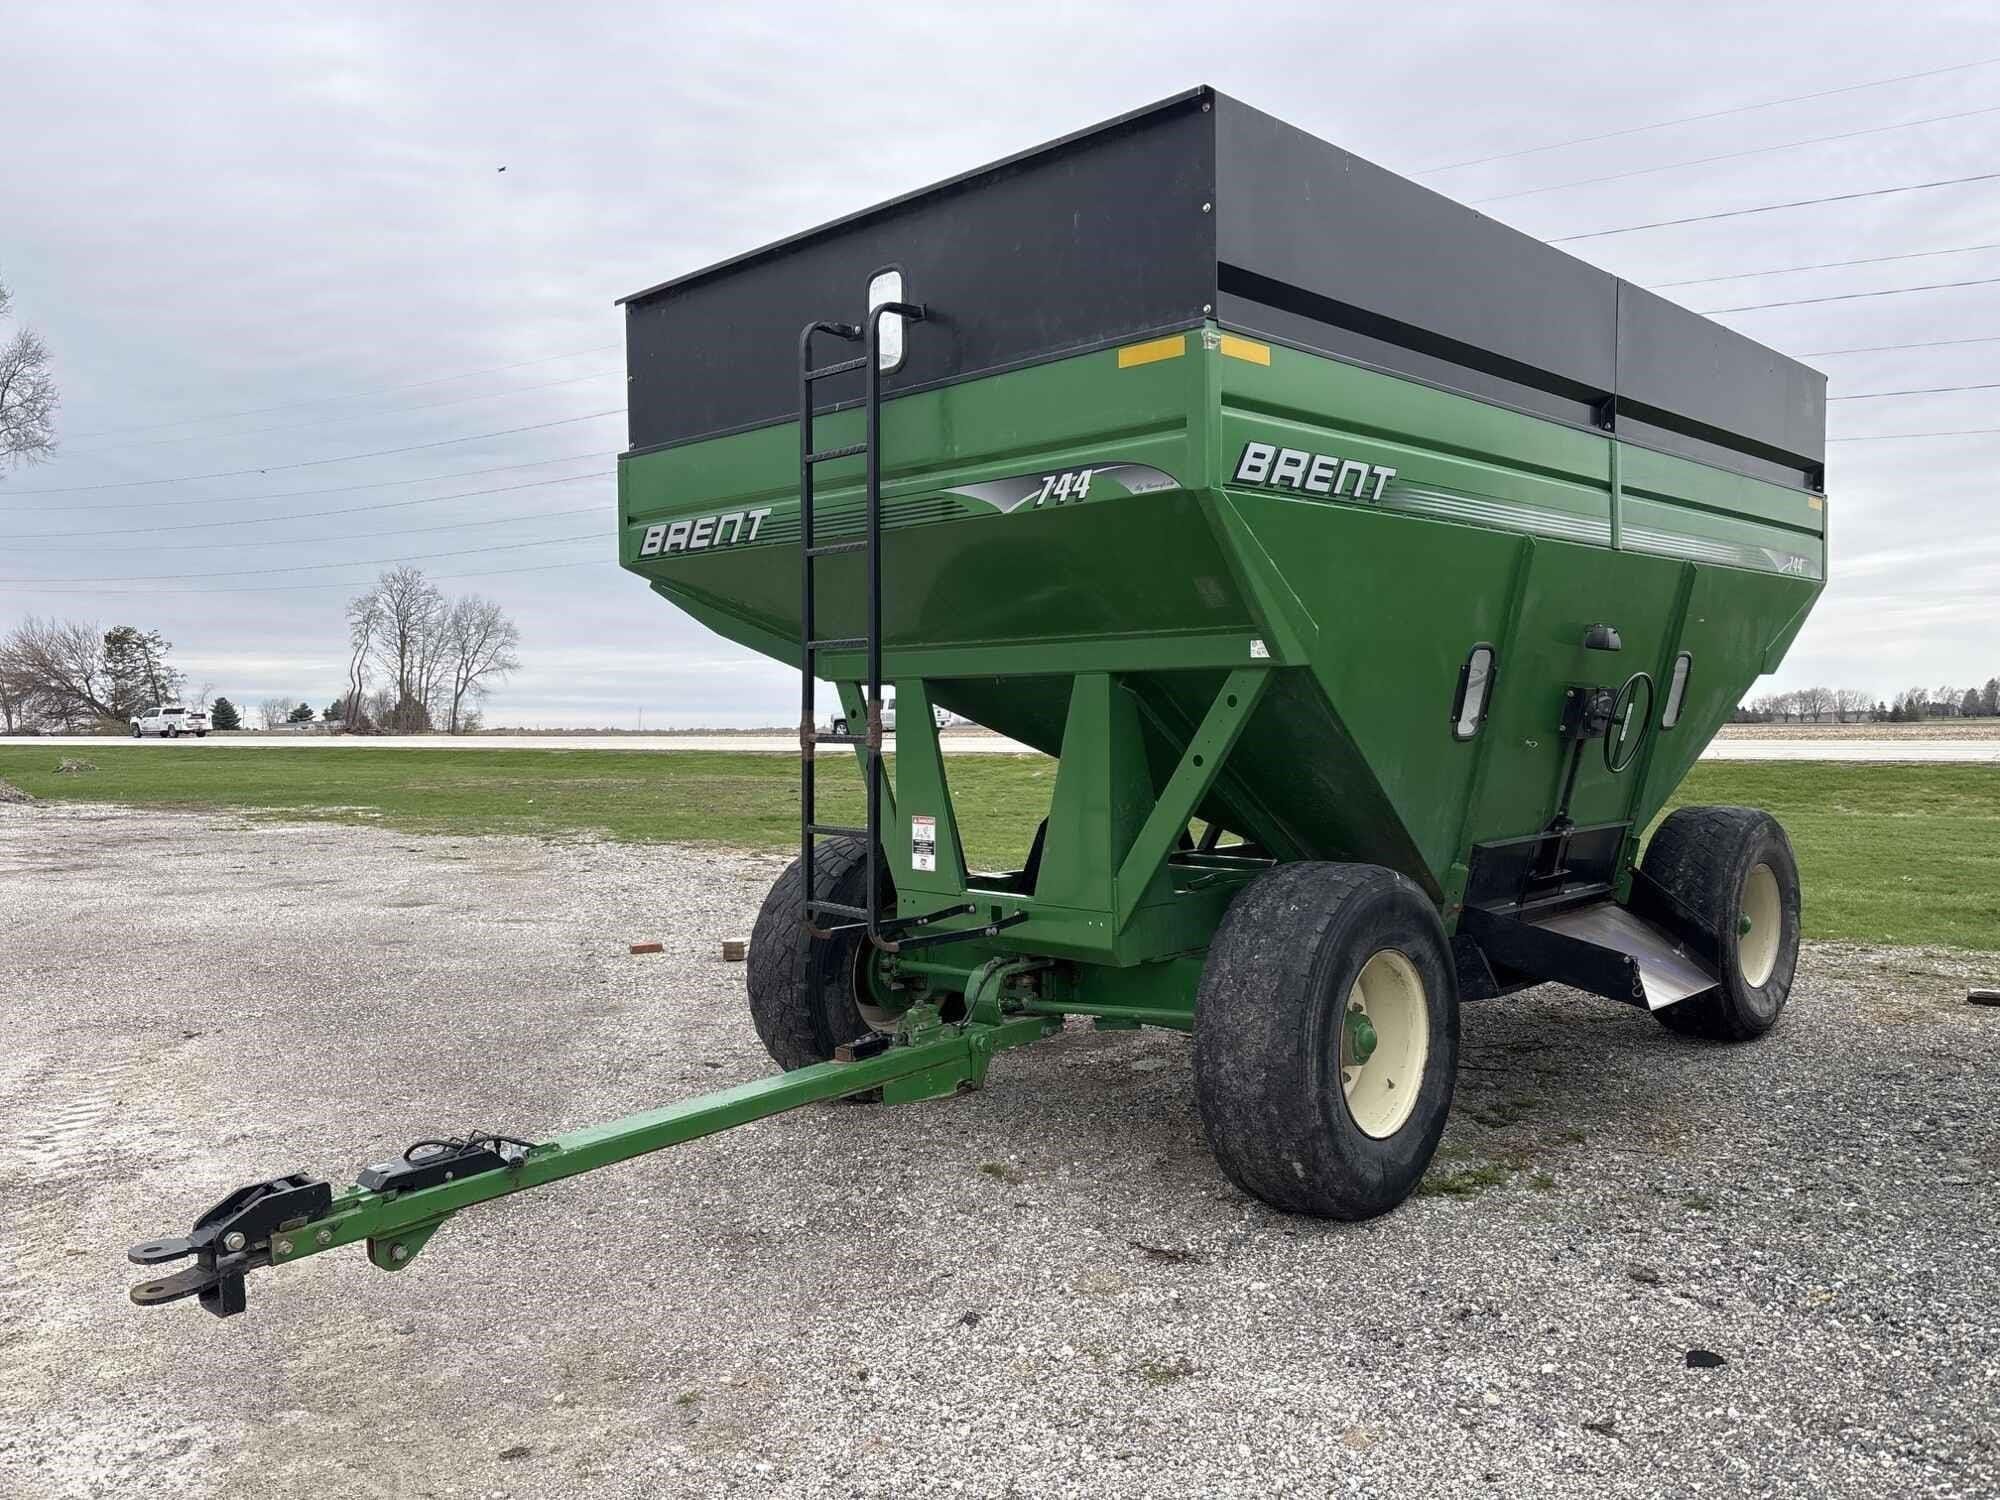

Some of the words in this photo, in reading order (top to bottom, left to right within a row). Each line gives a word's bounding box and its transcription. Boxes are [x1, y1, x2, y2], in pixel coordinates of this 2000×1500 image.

[1036, 469, 1094, 506] 744
[1234, 440, 1398, 501] BRENT
[638, 507, 773, 556] BRENT
